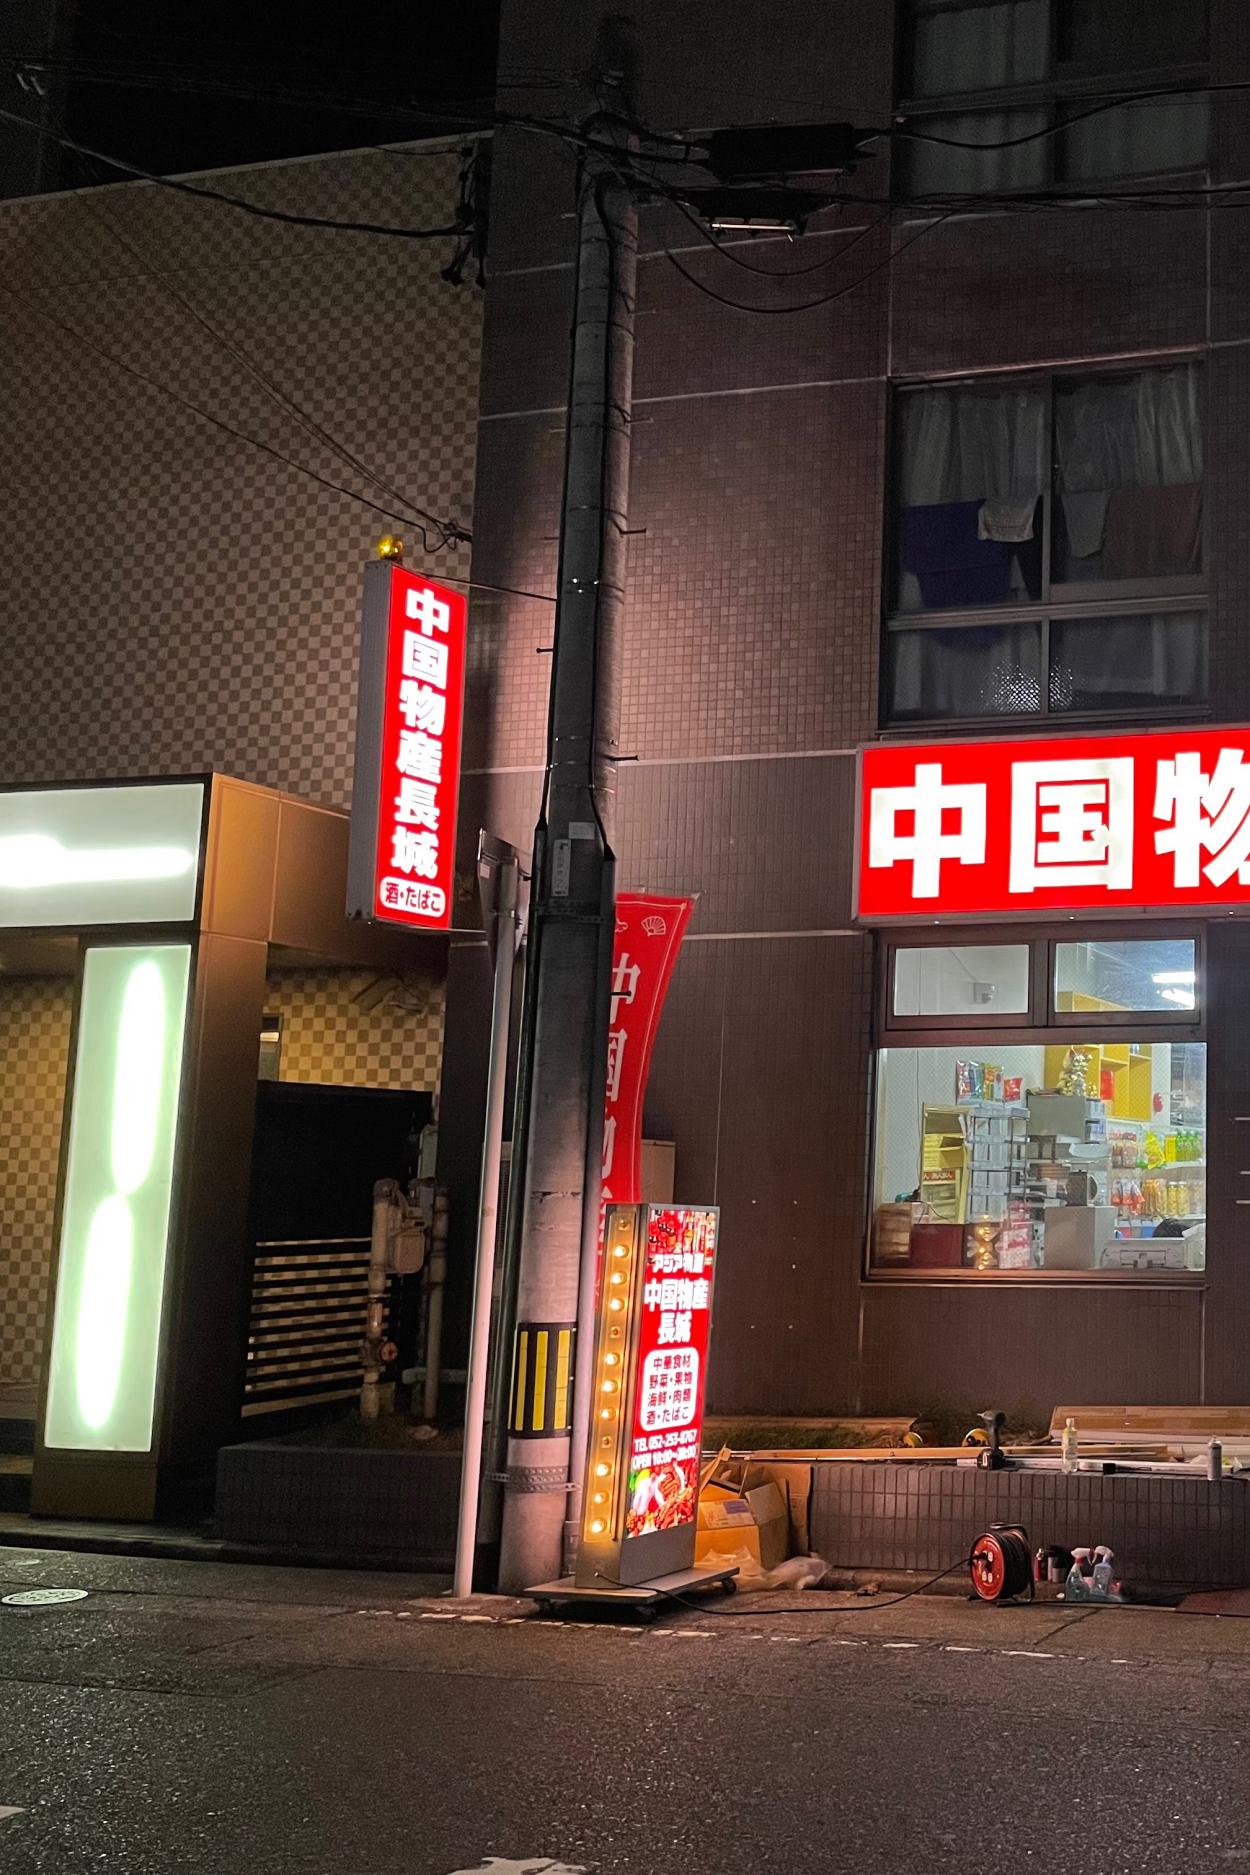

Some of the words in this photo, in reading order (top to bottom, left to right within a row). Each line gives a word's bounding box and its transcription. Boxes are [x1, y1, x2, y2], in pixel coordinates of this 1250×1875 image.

[391, 588, 450, 879] 中国物産長城
[644, 1278, 709, 1311] 中国物産
[658, 1311, 692, 1344] 長城
[653, 1354, 691, 1371] 中華食材
[634, 1438, 648, 1452] TEL
